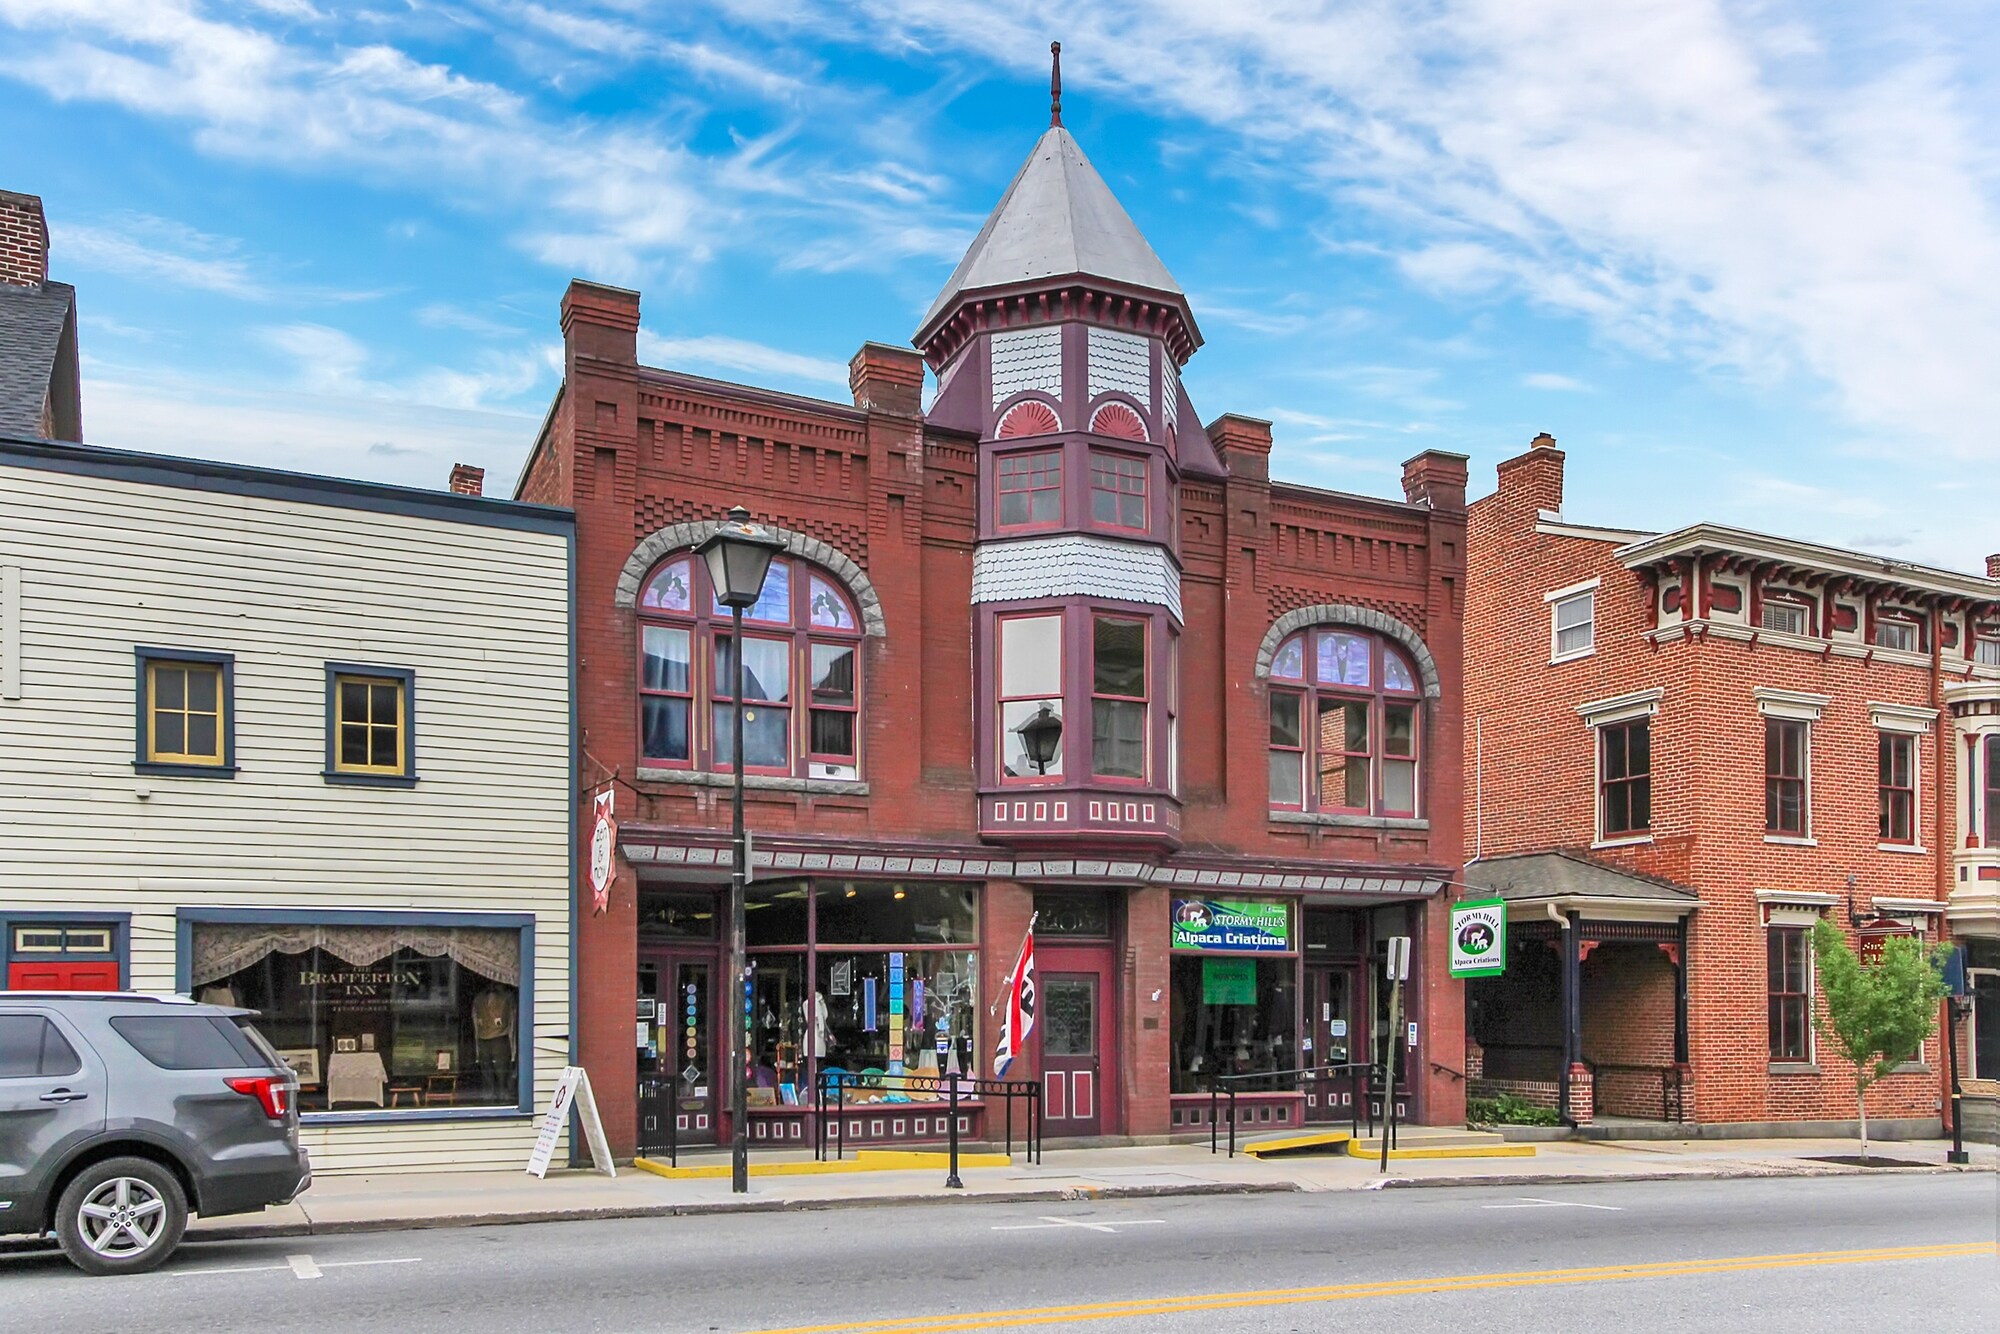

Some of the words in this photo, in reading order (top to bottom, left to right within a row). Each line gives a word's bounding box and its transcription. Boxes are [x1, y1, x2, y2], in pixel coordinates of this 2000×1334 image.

[1214, 914, 1255, 927] STORMY
[1256, 916, 1286, 928] HILL'S
[1176, 931, 1222, 945] Alpaca
[1225, 932, 1286, 946] Criations
[1473, 956, 1500, 965] Criations
[300, 971, 421, 986] BRAFFERTON
[346, 985, 377, 995] INN
